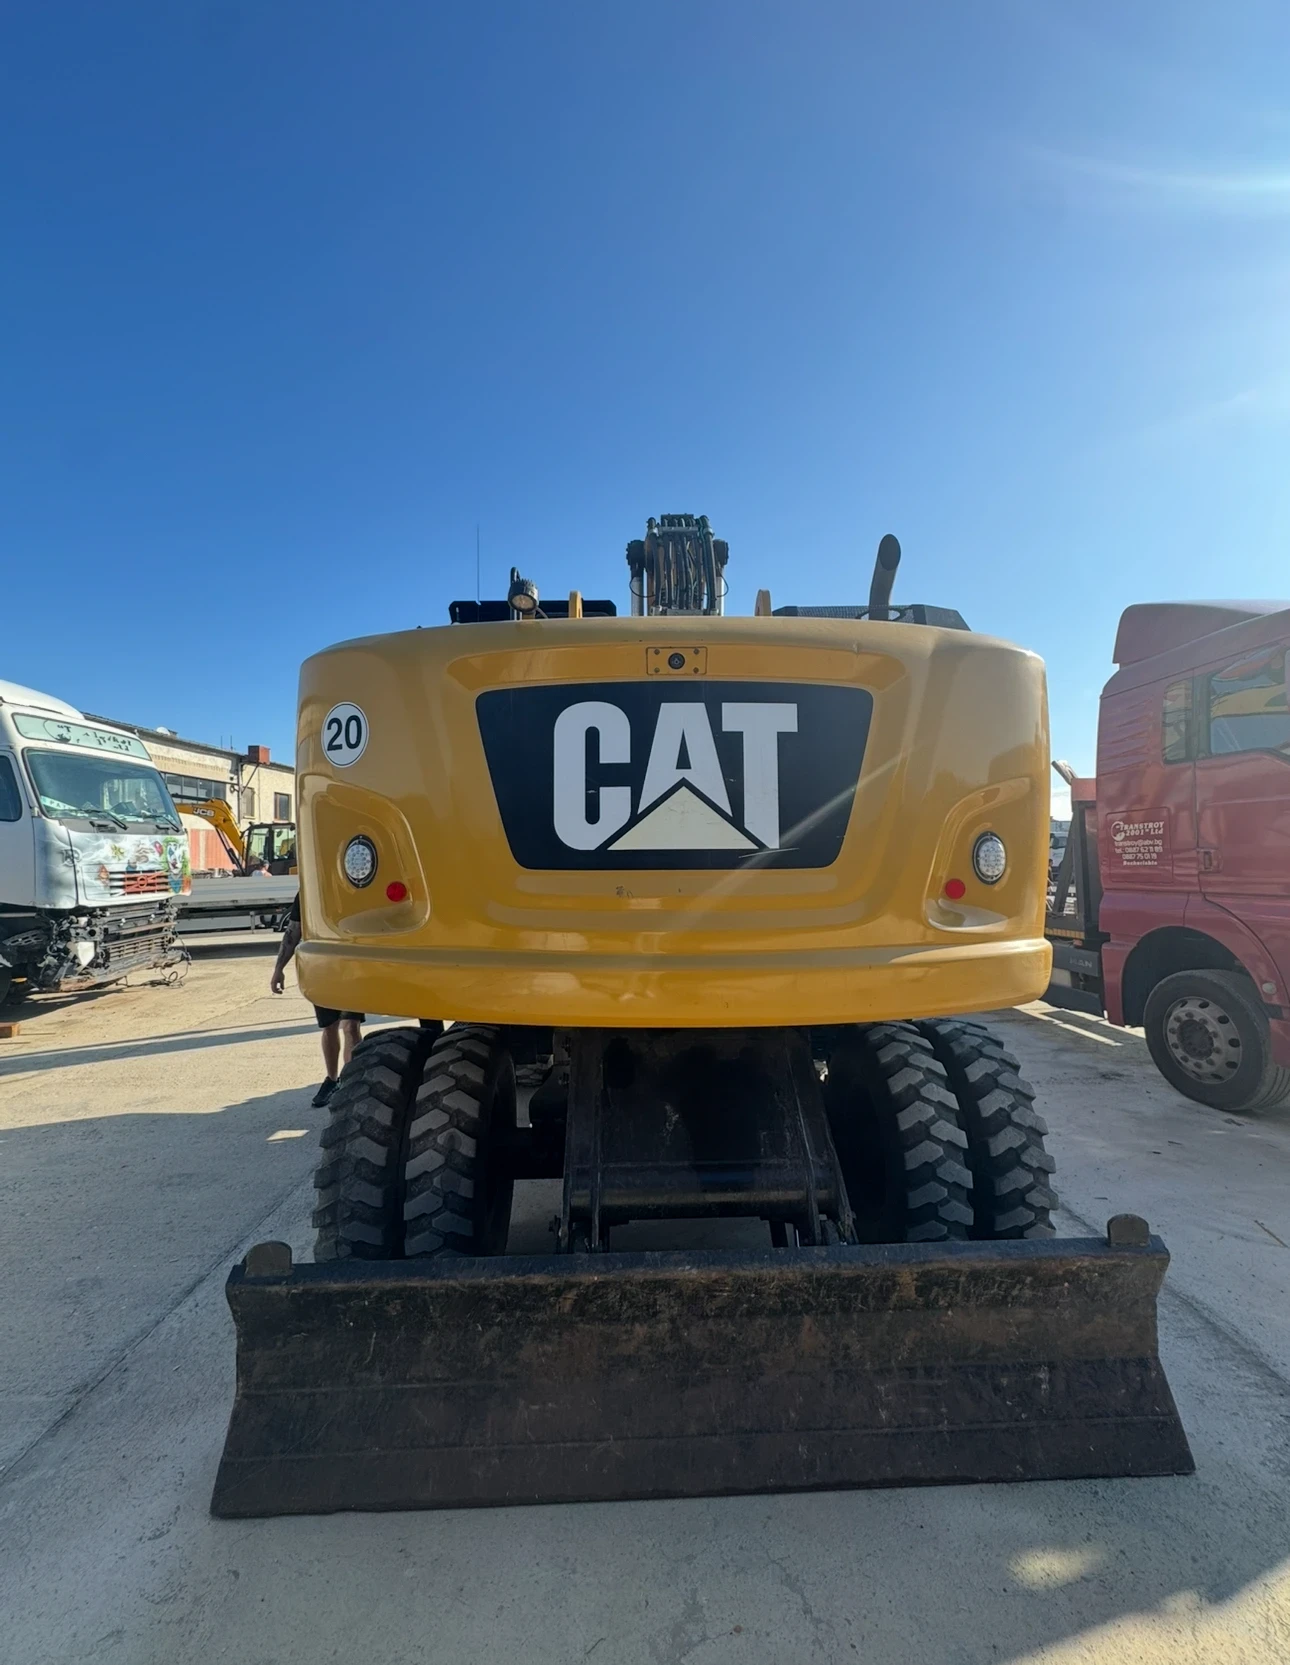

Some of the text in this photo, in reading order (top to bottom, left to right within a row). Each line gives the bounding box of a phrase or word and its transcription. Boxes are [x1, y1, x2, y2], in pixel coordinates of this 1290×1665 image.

[327, 715, 362, 751] 20
[553, 701, 798, 850] CAT
[193, 807, 214, 817] JCB
